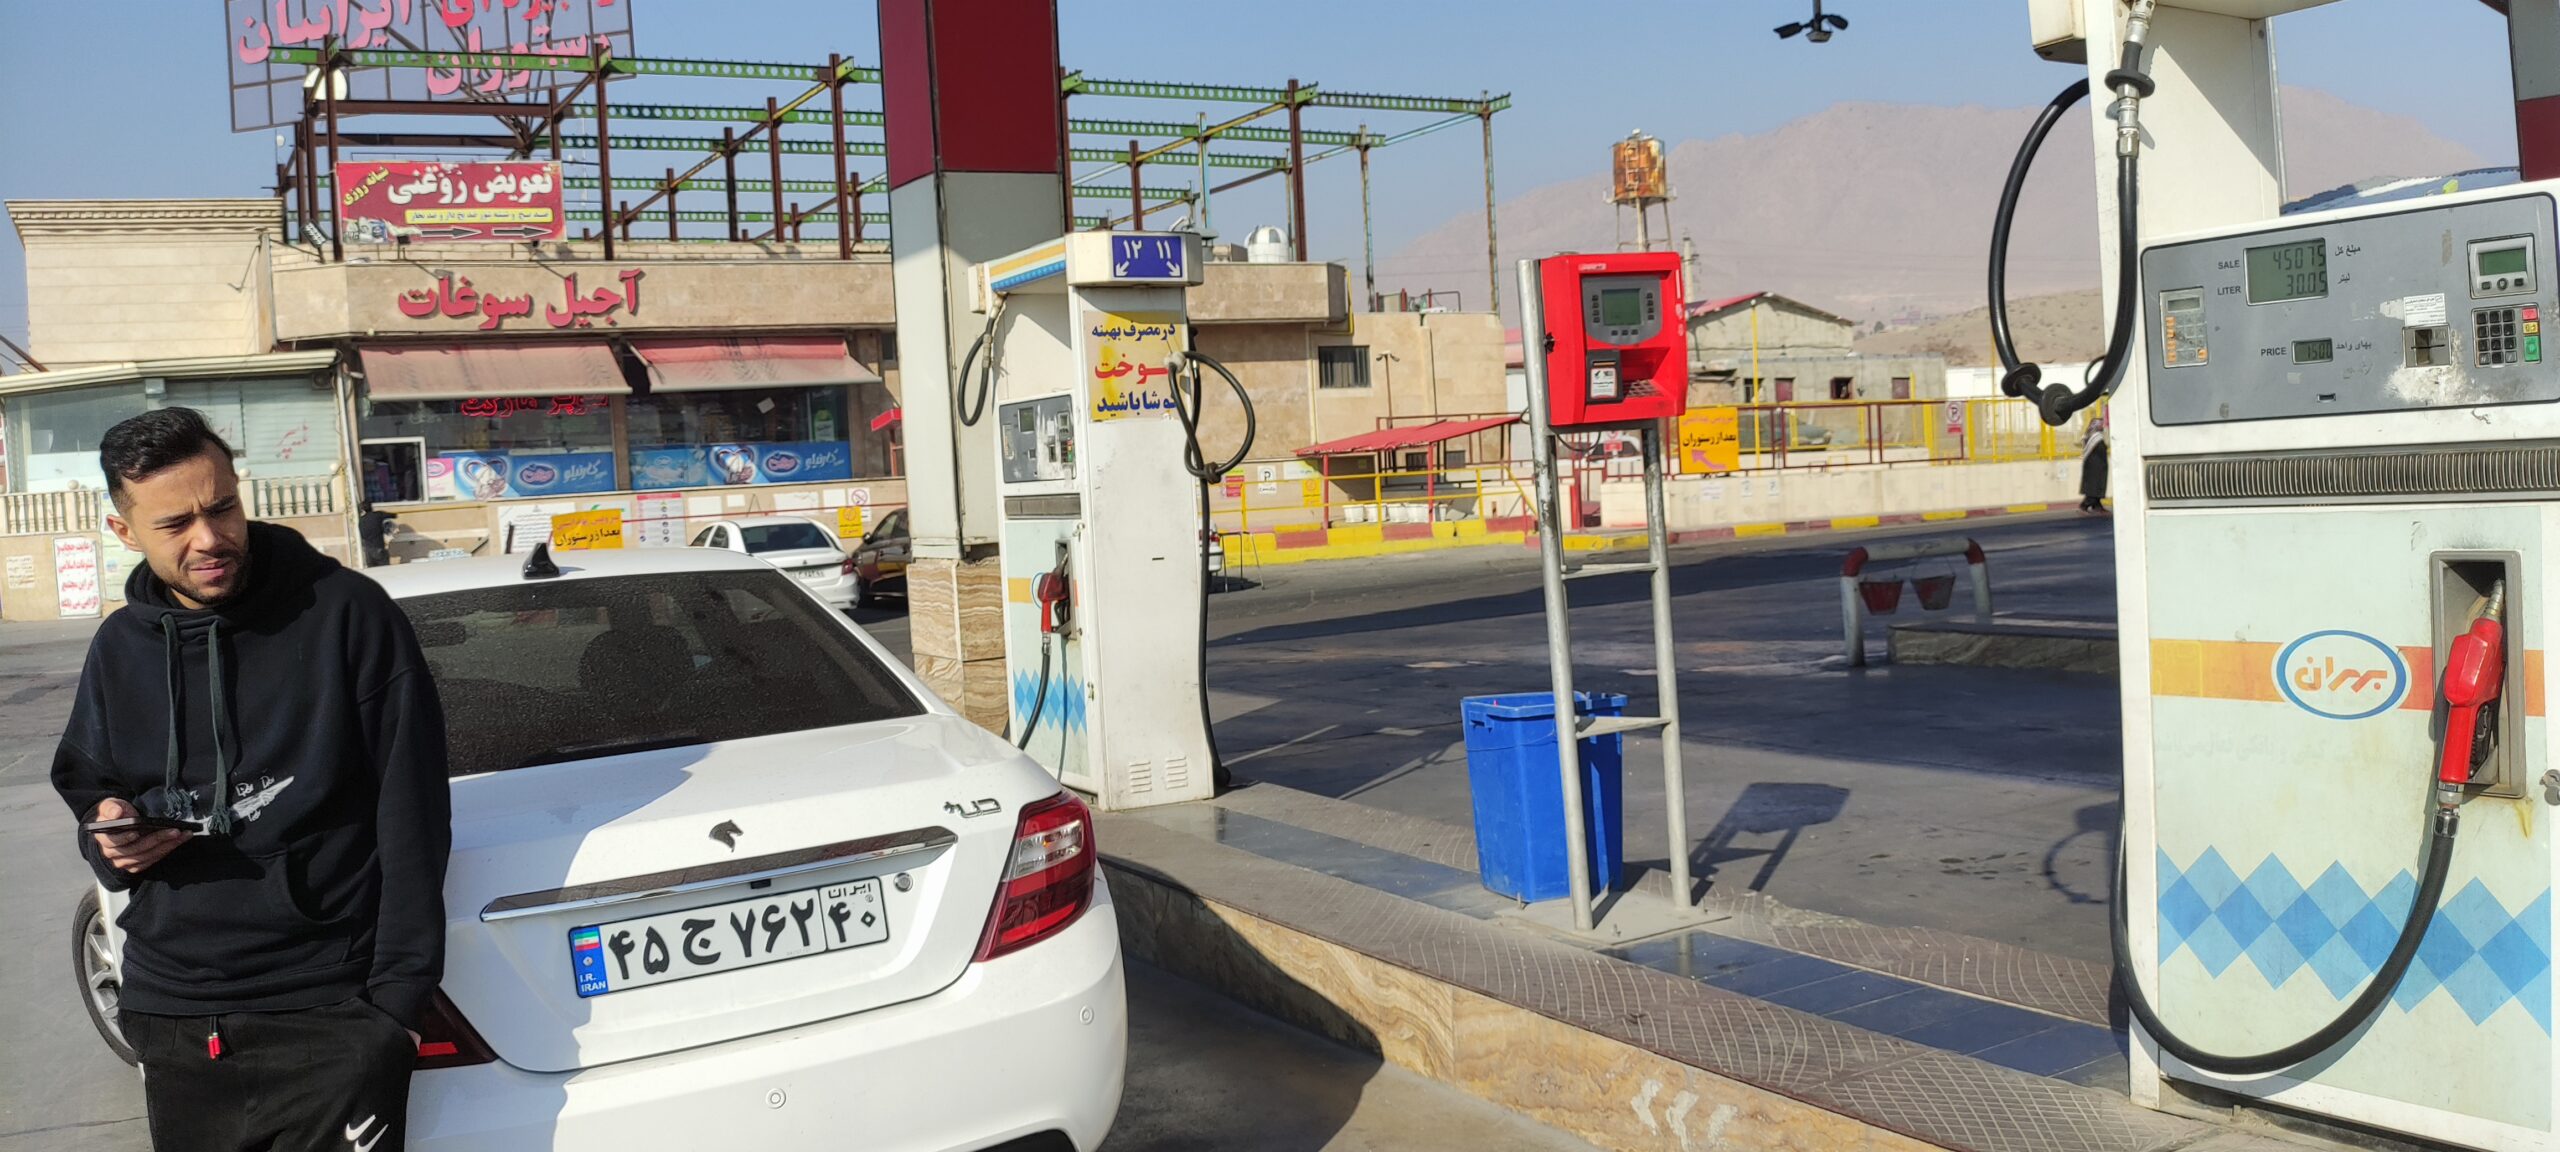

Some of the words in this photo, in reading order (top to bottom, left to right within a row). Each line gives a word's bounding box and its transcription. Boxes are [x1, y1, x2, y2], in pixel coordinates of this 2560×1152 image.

[388, 165, 468, 204] روغنی
[473, 164, 553, 203] تعویض
[1123, 240, 1142, 259] ۱۲
[1156, 240, 1171, 259] ۱۱
[2272, 245, 2325, 270] 45075
[2217, 259, 2240, 270] SALE
[2217, 286, 2241, 296] LITER
[2286, 271, 2327, 296] 30.05
[398, 275, 532, 330] سوغات
[546, 268, 641, 328] آجیل
[1092, 324, 1121, 341] بهینه
[1123, 320, 1160, 341] مصرف
[1161, 323, 1176, 340] در
[2261, 347, 2287, 356] PRICE
[828, 883, 871, 898] ایران
[608, 925, 670, 980] ۴۵
[681, 919, 721, 965] ج
[730, 898, 814, 958] ۷۶۲
[828, 902, 876, 943] ۴۰
[580, 973, 596, 983] I.R.
[581, 981, 606, 992] IRAN
